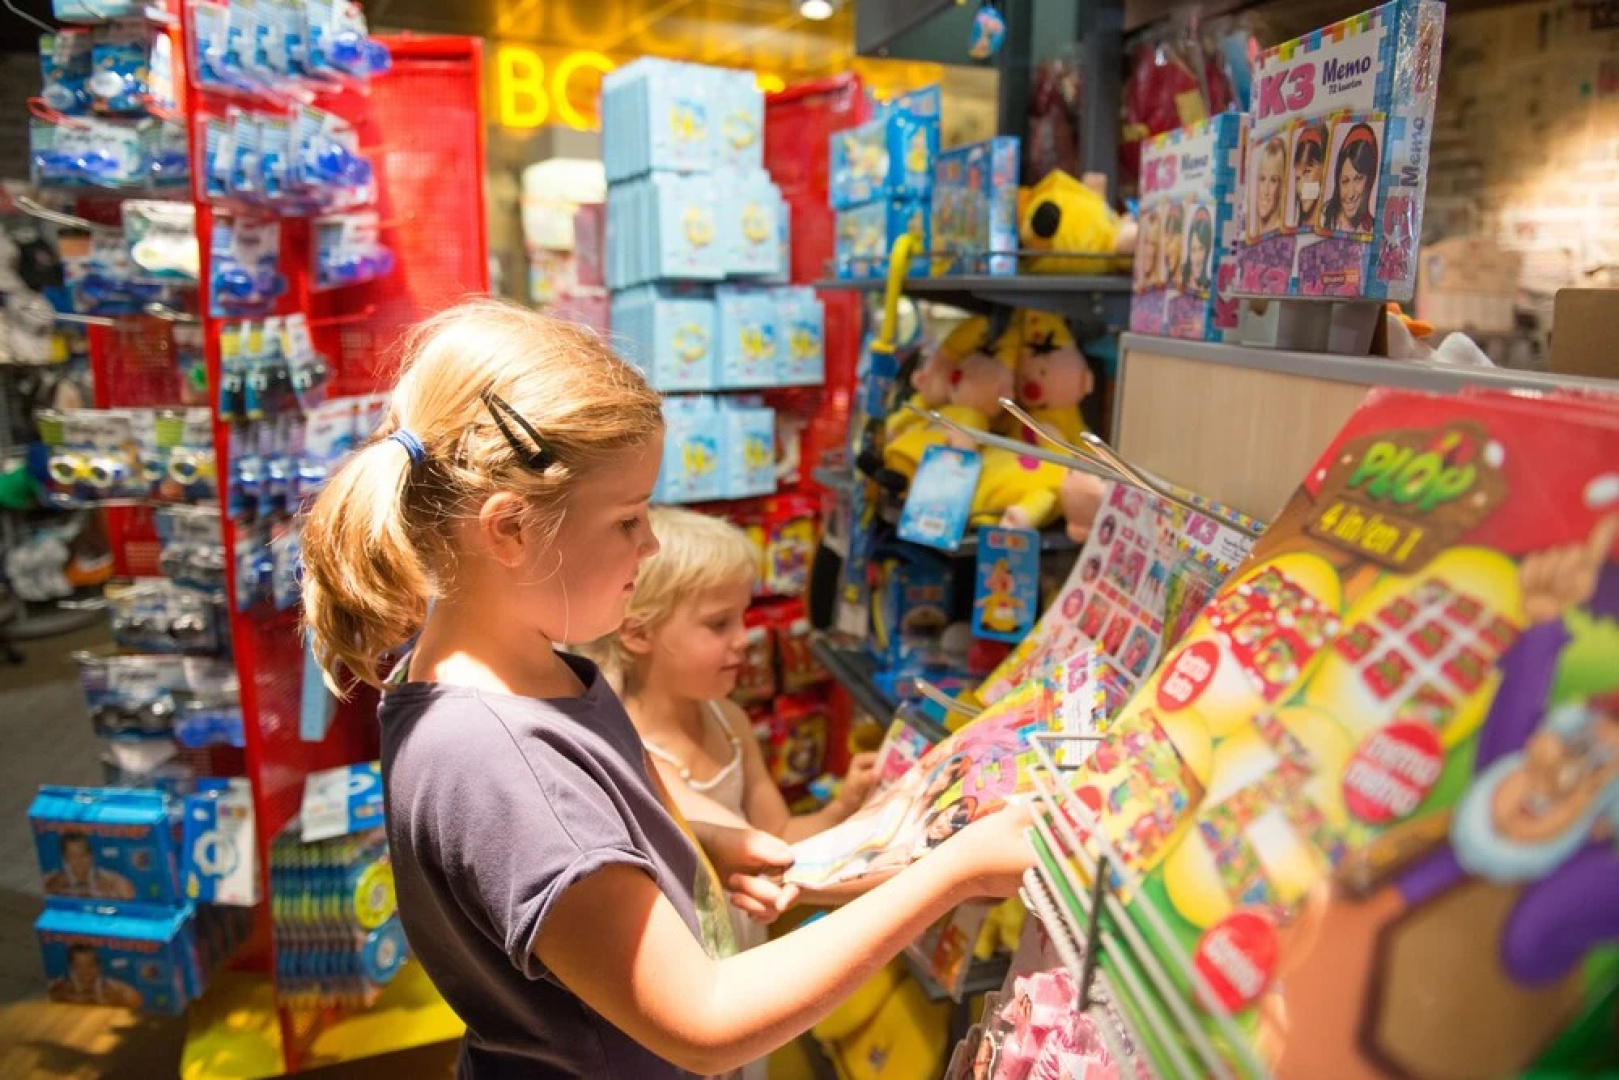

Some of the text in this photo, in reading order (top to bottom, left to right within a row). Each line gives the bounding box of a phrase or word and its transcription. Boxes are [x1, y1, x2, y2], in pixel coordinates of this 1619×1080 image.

[1258, 62, 1316, 119] K3
[1322, 56, 1371, 86] Memo
[1144, 154, 1178, 195] K3
[1401, 116, 1426, 188] Memo
[1186, 512, 1220, 546] K3
